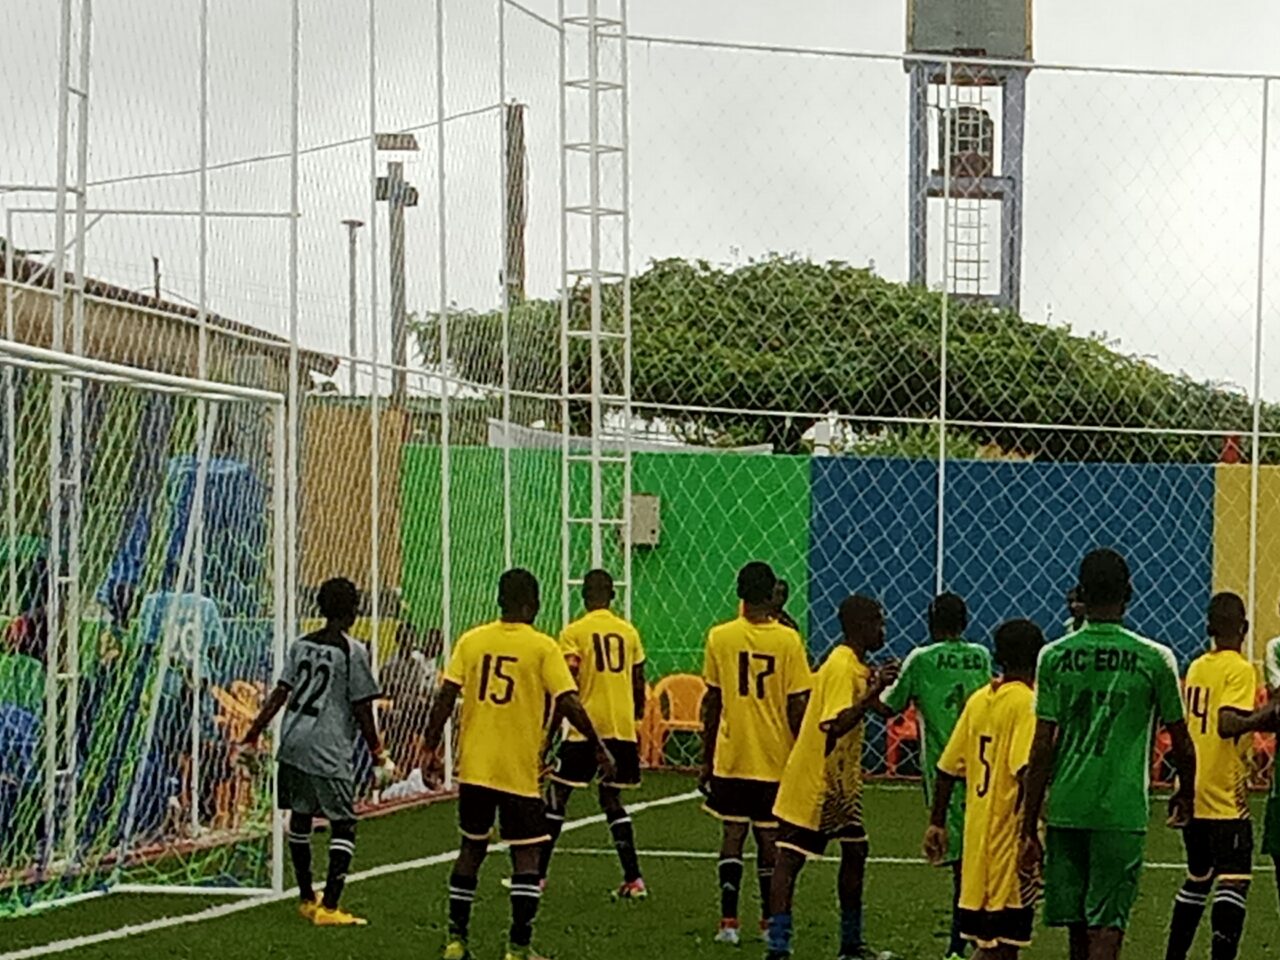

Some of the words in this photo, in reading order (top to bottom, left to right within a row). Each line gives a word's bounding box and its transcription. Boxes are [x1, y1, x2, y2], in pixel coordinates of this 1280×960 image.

[592, 632, 625, 673] 10
[738, 651, 776, 700] 17
[1060, 649, 1087, 673] AC
[287, 660, 330, 717] 22
[478, 653, 518, 705] 15
[1187, 686, 1210, 734] 14
[976, 734, 993, 798] 5
